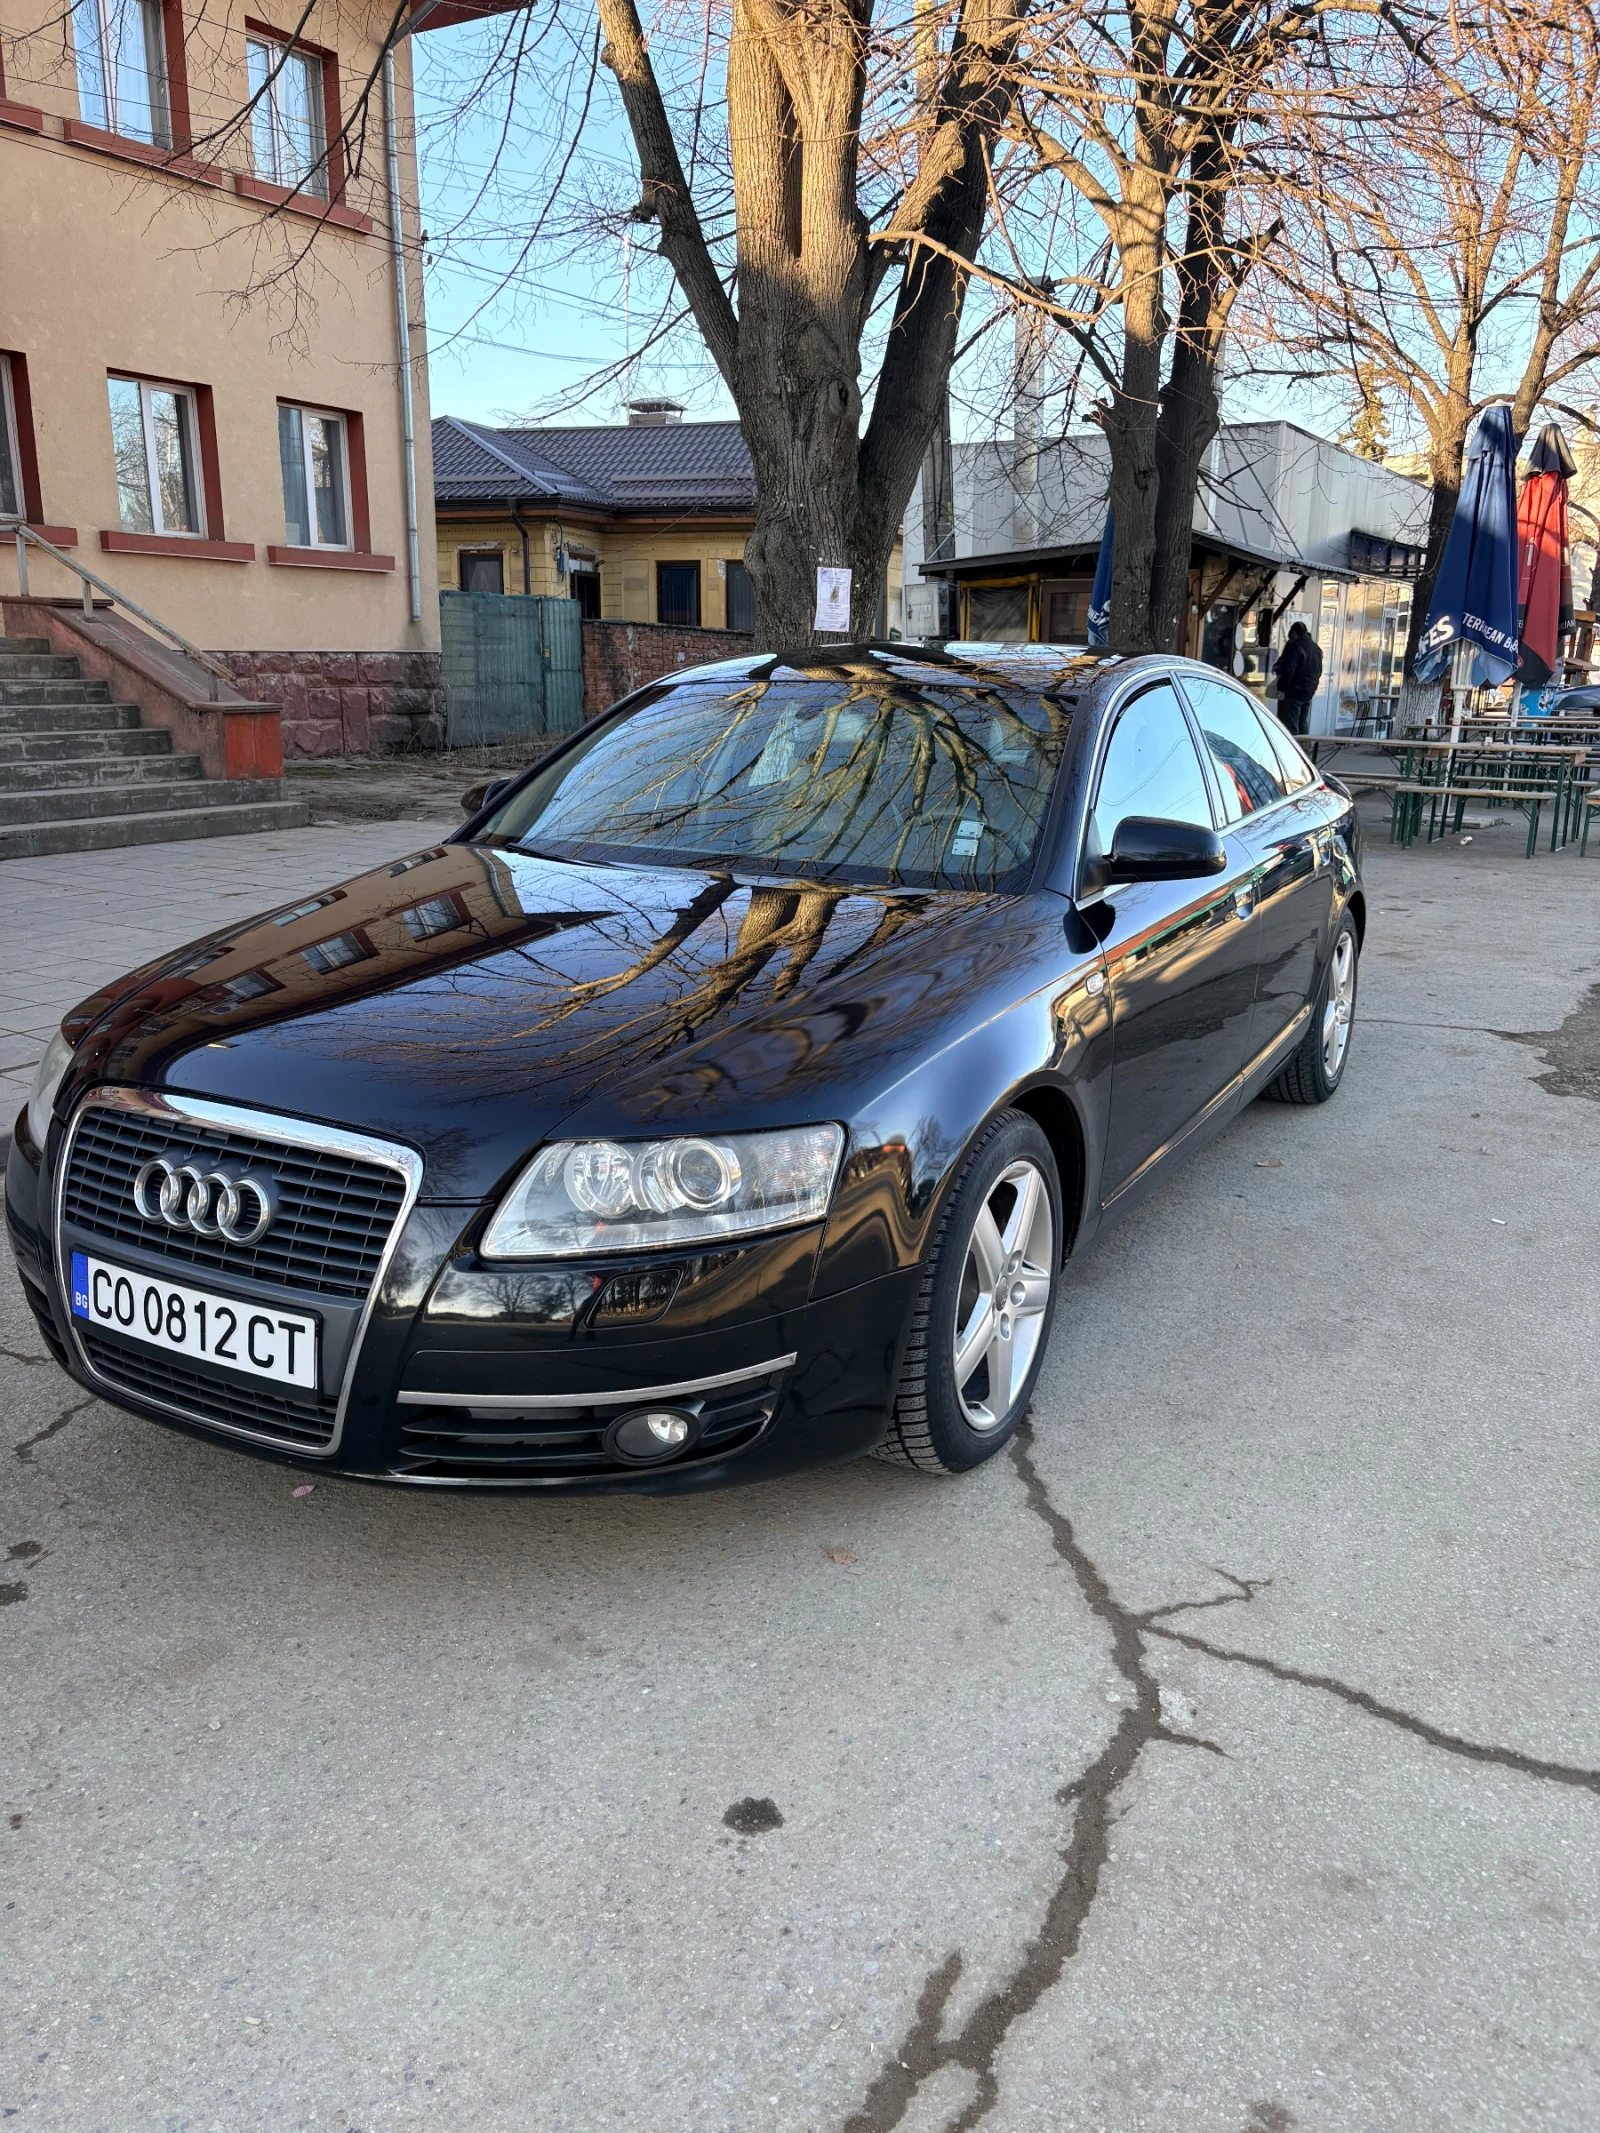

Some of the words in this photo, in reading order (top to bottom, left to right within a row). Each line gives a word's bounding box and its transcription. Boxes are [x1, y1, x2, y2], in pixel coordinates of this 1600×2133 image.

[75, 1291, 88, 1309] BG
[93, 1269, 134, 1326] CO
[143, 1286, 237, 1360] 0812
[248, 1315, 306, 1375] CT
